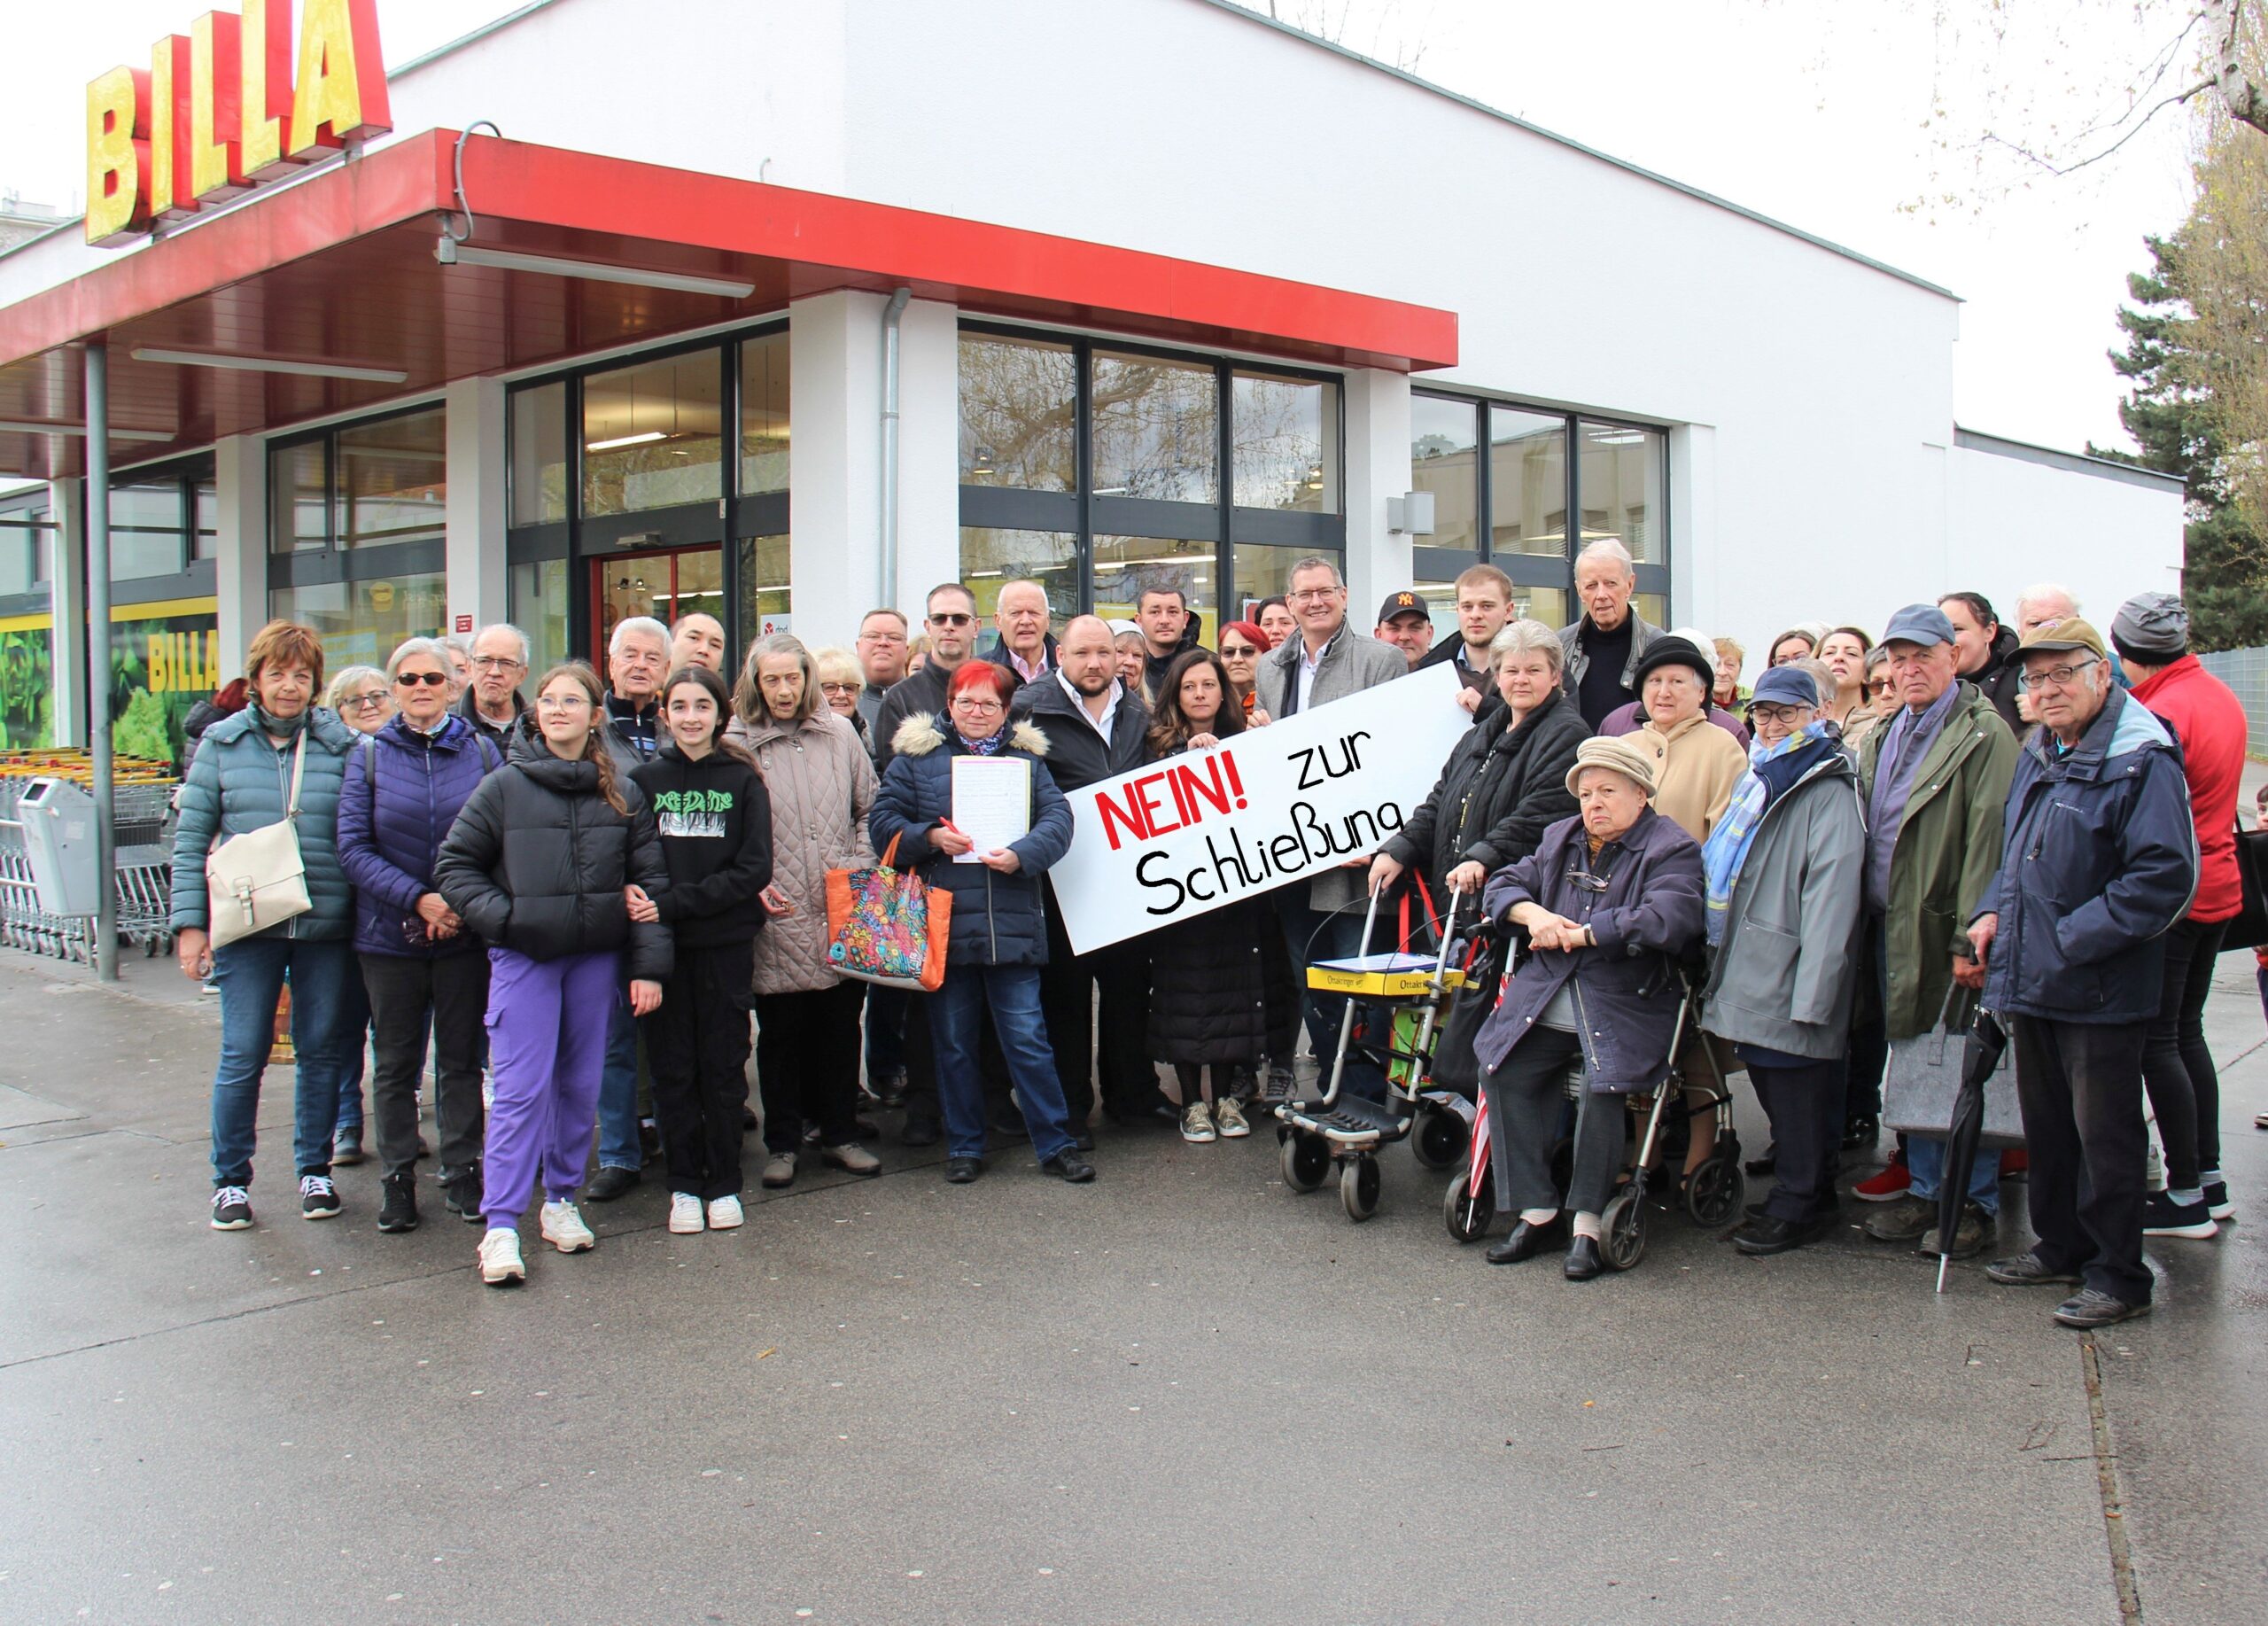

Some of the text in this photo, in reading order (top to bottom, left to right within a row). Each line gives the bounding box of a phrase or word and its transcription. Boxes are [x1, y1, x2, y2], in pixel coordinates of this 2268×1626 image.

[86, 0, 391, 248] BILLA
[148, 629, 220, 693] BILLA
[1095, 751, 1247, 850] NEIN!
[1287, 731, 1371, 790] zur
